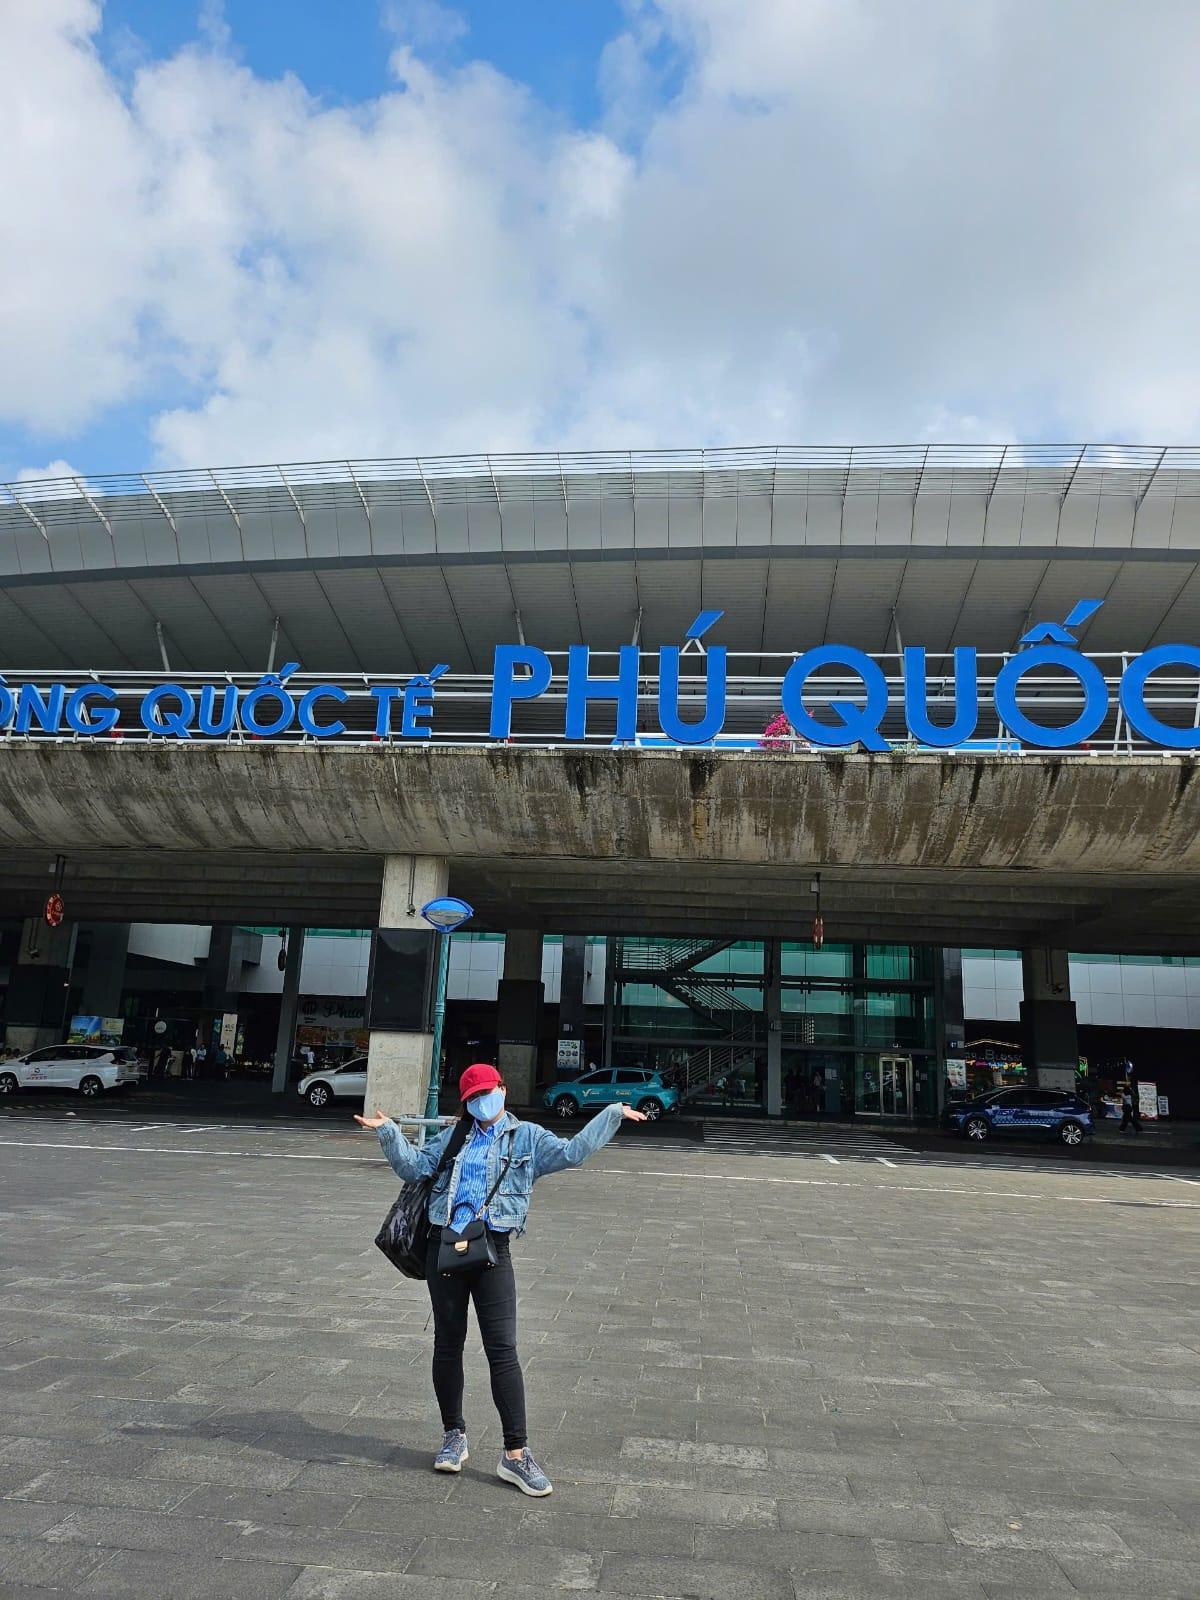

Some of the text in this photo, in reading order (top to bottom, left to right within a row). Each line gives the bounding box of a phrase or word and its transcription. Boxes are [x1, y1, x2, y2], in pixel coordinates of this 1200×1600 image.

[141, 662, 347, 738] QUỐC
[372, 664, 450, 738] TẾ
[490, 611, 726, 746] PHÚ
[782, 599, 1200, 752] QUỐC
